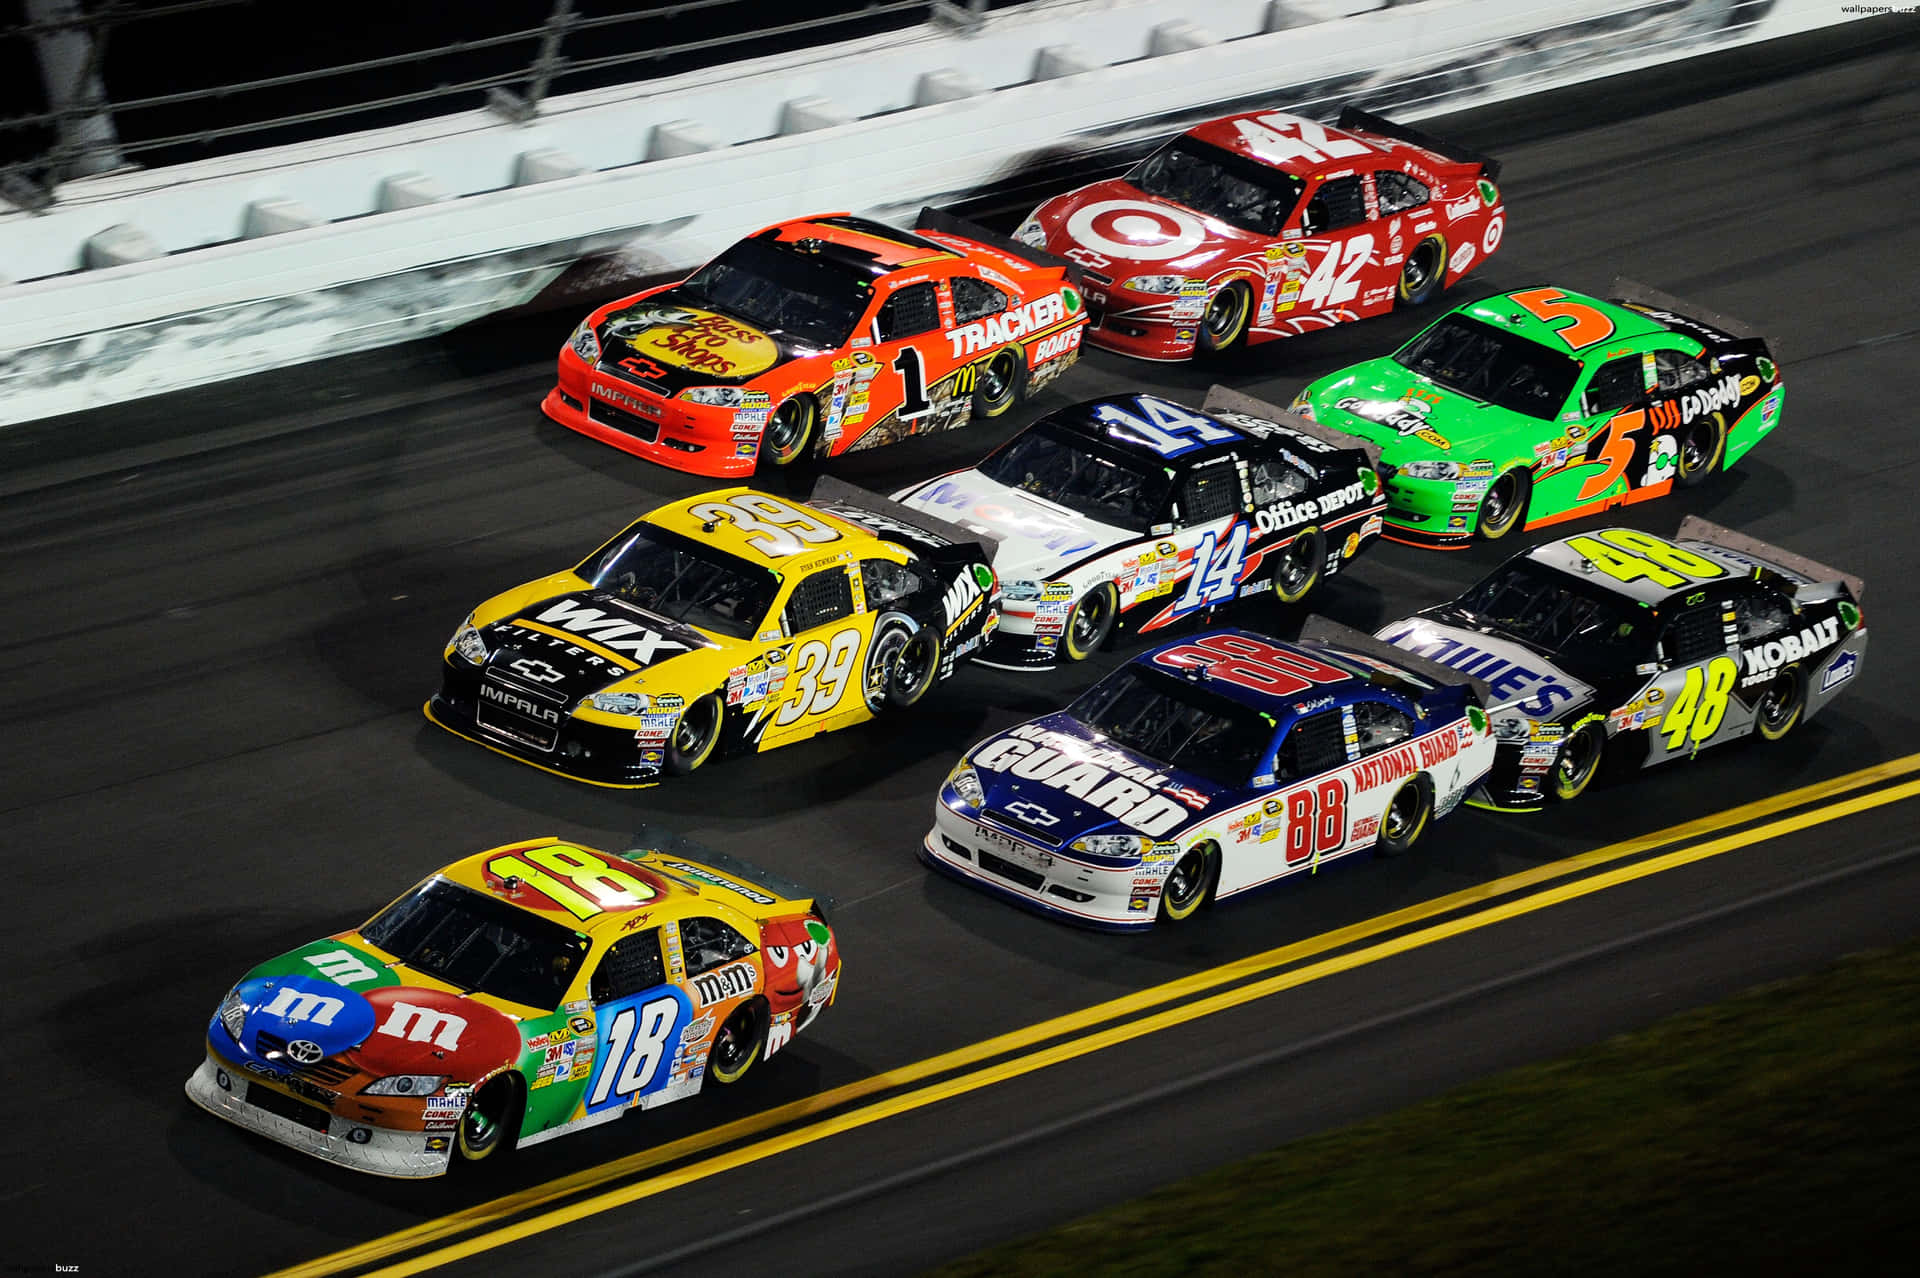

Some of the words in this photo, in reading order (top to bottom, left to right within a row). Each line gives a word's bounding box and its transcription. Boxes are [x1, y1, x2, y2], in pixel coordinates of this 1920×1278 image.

[1231, 112, 1373, 165] 42
[1298, 234, 1375, 310] 42
[691, 315, 763, 344] Bass
[946, 292, 1065, 360] TRACKER
[1033, 325, 1083, 363] BOATS
[1507, 288, 1616, 351] 5
[651, 333, 737, 374] Shops
[893, 346, 937, 421] 1
[591, 382, 662, 417] IMPALA
[1090, 396, 1243, 459] 14
[1576, 408, 1646, 501] 5
[688, 494, 843, 559] 39
[1255, 499, 1319, 535] Office
[1320, 482, 1366, 515] DEPOT
[1170, 521, 1251, 617] 14
[1563, 529, 1727, 590] 48
[942, 564, 981, 627] WIX
[493, 625, 625, 677] FILTERS
[535, 599, 692, 665] WIX
[1743, 616, 1839, 675] KOBALT
[775, 629, 862, 726] 39
[1151, 634, 1353, 696] 88
[480, 684, 560, 724] IMPALA
[1660, 656, 1737, 750] 48
[972, 738, 1189, 837] GUARD
[1352, 747, 1418, 794] NATIONAL
[1419, 730, 1458, 769] GUARD
[1285, 777, 1351, 867] 88
[488, 844, 656, 921] 18
[546, 1045, 563, 1063] 3M
[590, 997, 681, 1107] 18
[428, 1096, 466, 1107] MAHLE
